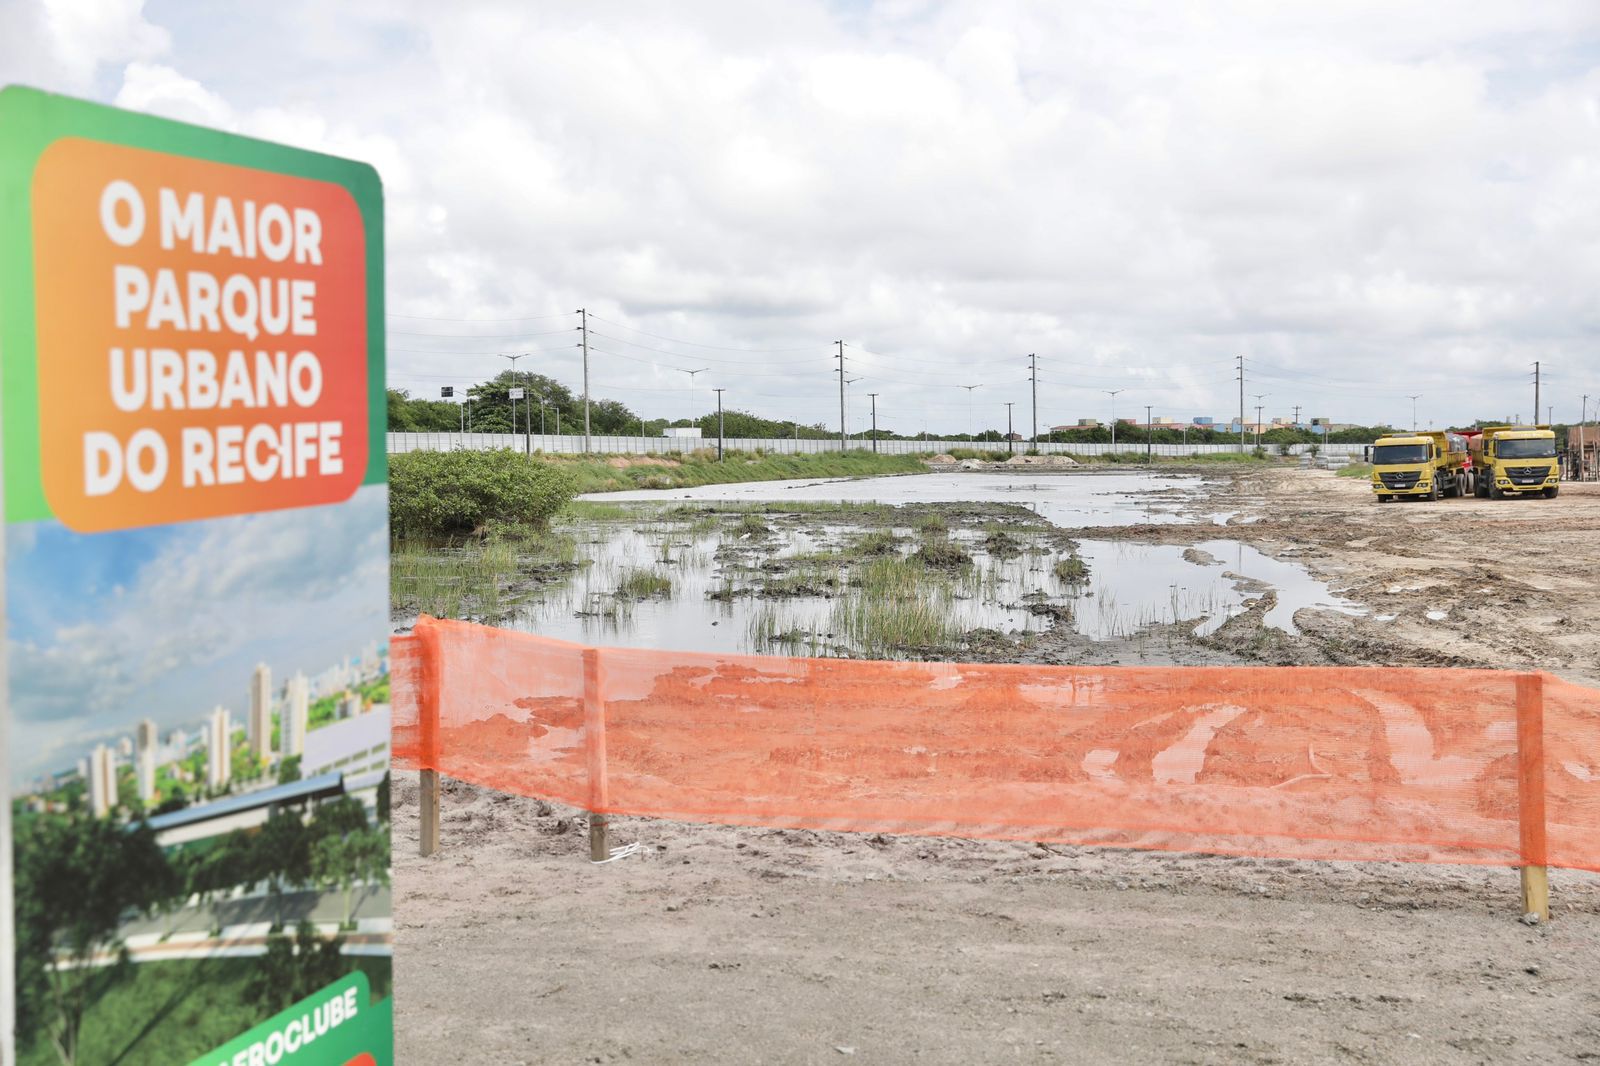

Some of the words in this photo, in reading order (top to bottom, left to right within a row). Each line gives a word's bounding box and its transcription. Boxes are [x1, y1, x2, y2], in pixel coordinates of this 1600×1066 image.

[100, 180, 145, 246] O
[160, 188, 322, 265] MAIOR
[113, 264, 317, 341] PARQUE
[110, 348, 322, 412] URBANO
[84, 428, 168, 496] DO
[182, 421, 343, 487] RECIFE
[219, 986, 357, 1066] EROCLUBE
